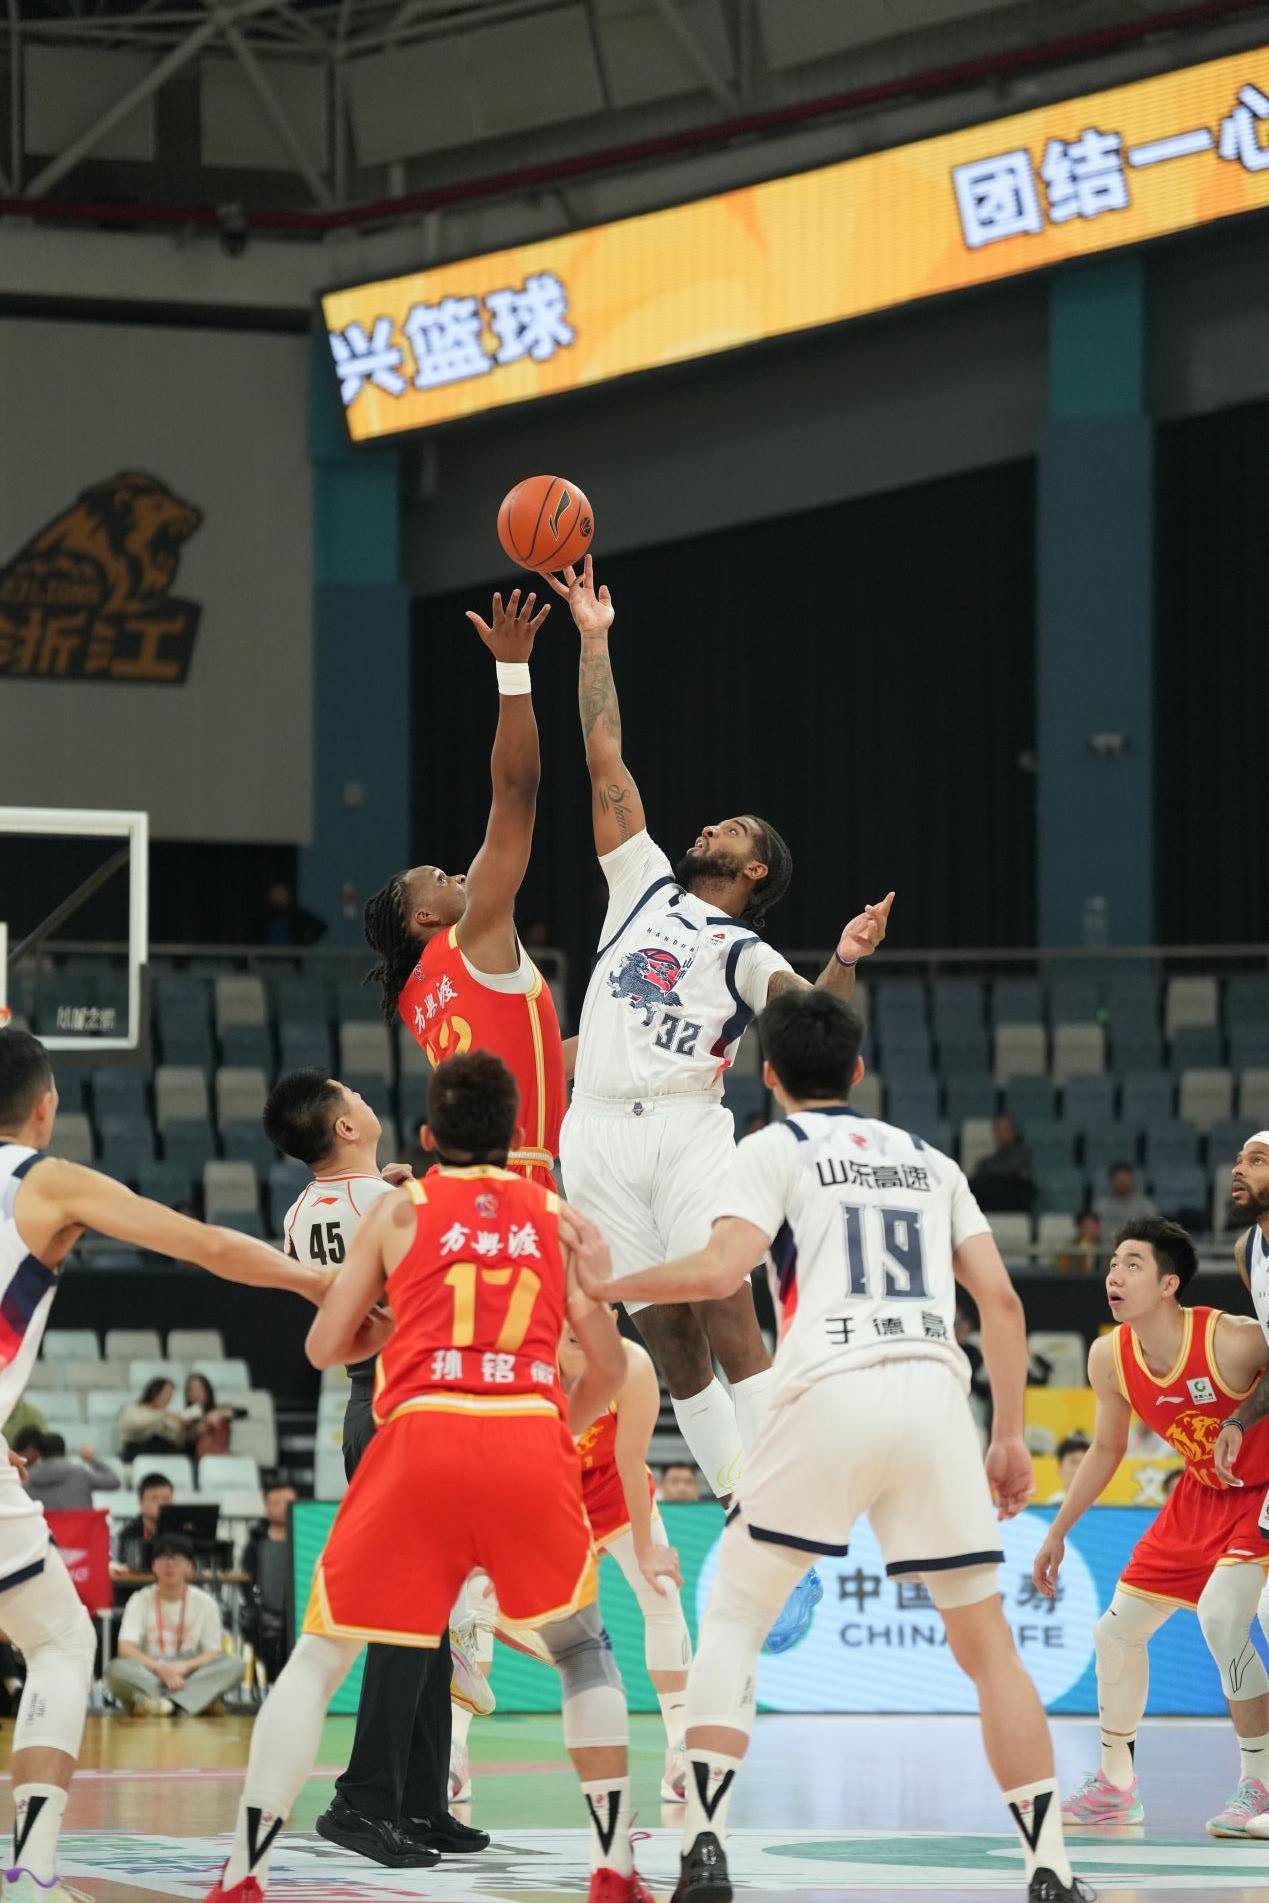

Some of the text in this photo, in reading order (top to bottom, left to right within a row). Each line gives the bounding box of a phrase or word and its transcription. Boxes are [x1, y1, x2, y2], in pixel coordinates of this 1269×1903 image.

[329, 273, 576, 405] 兴篮球
[816, 1157, 932, 1192] 山东高速
[310, 1221, 346, 1266] 45
[840, 1201, 935, 1300] 19
[443, 1261, 542, 1353] 17
[837, 1566, 1066, 1615] 中国寿
[840, 1623, 947, 1648] CHIN
